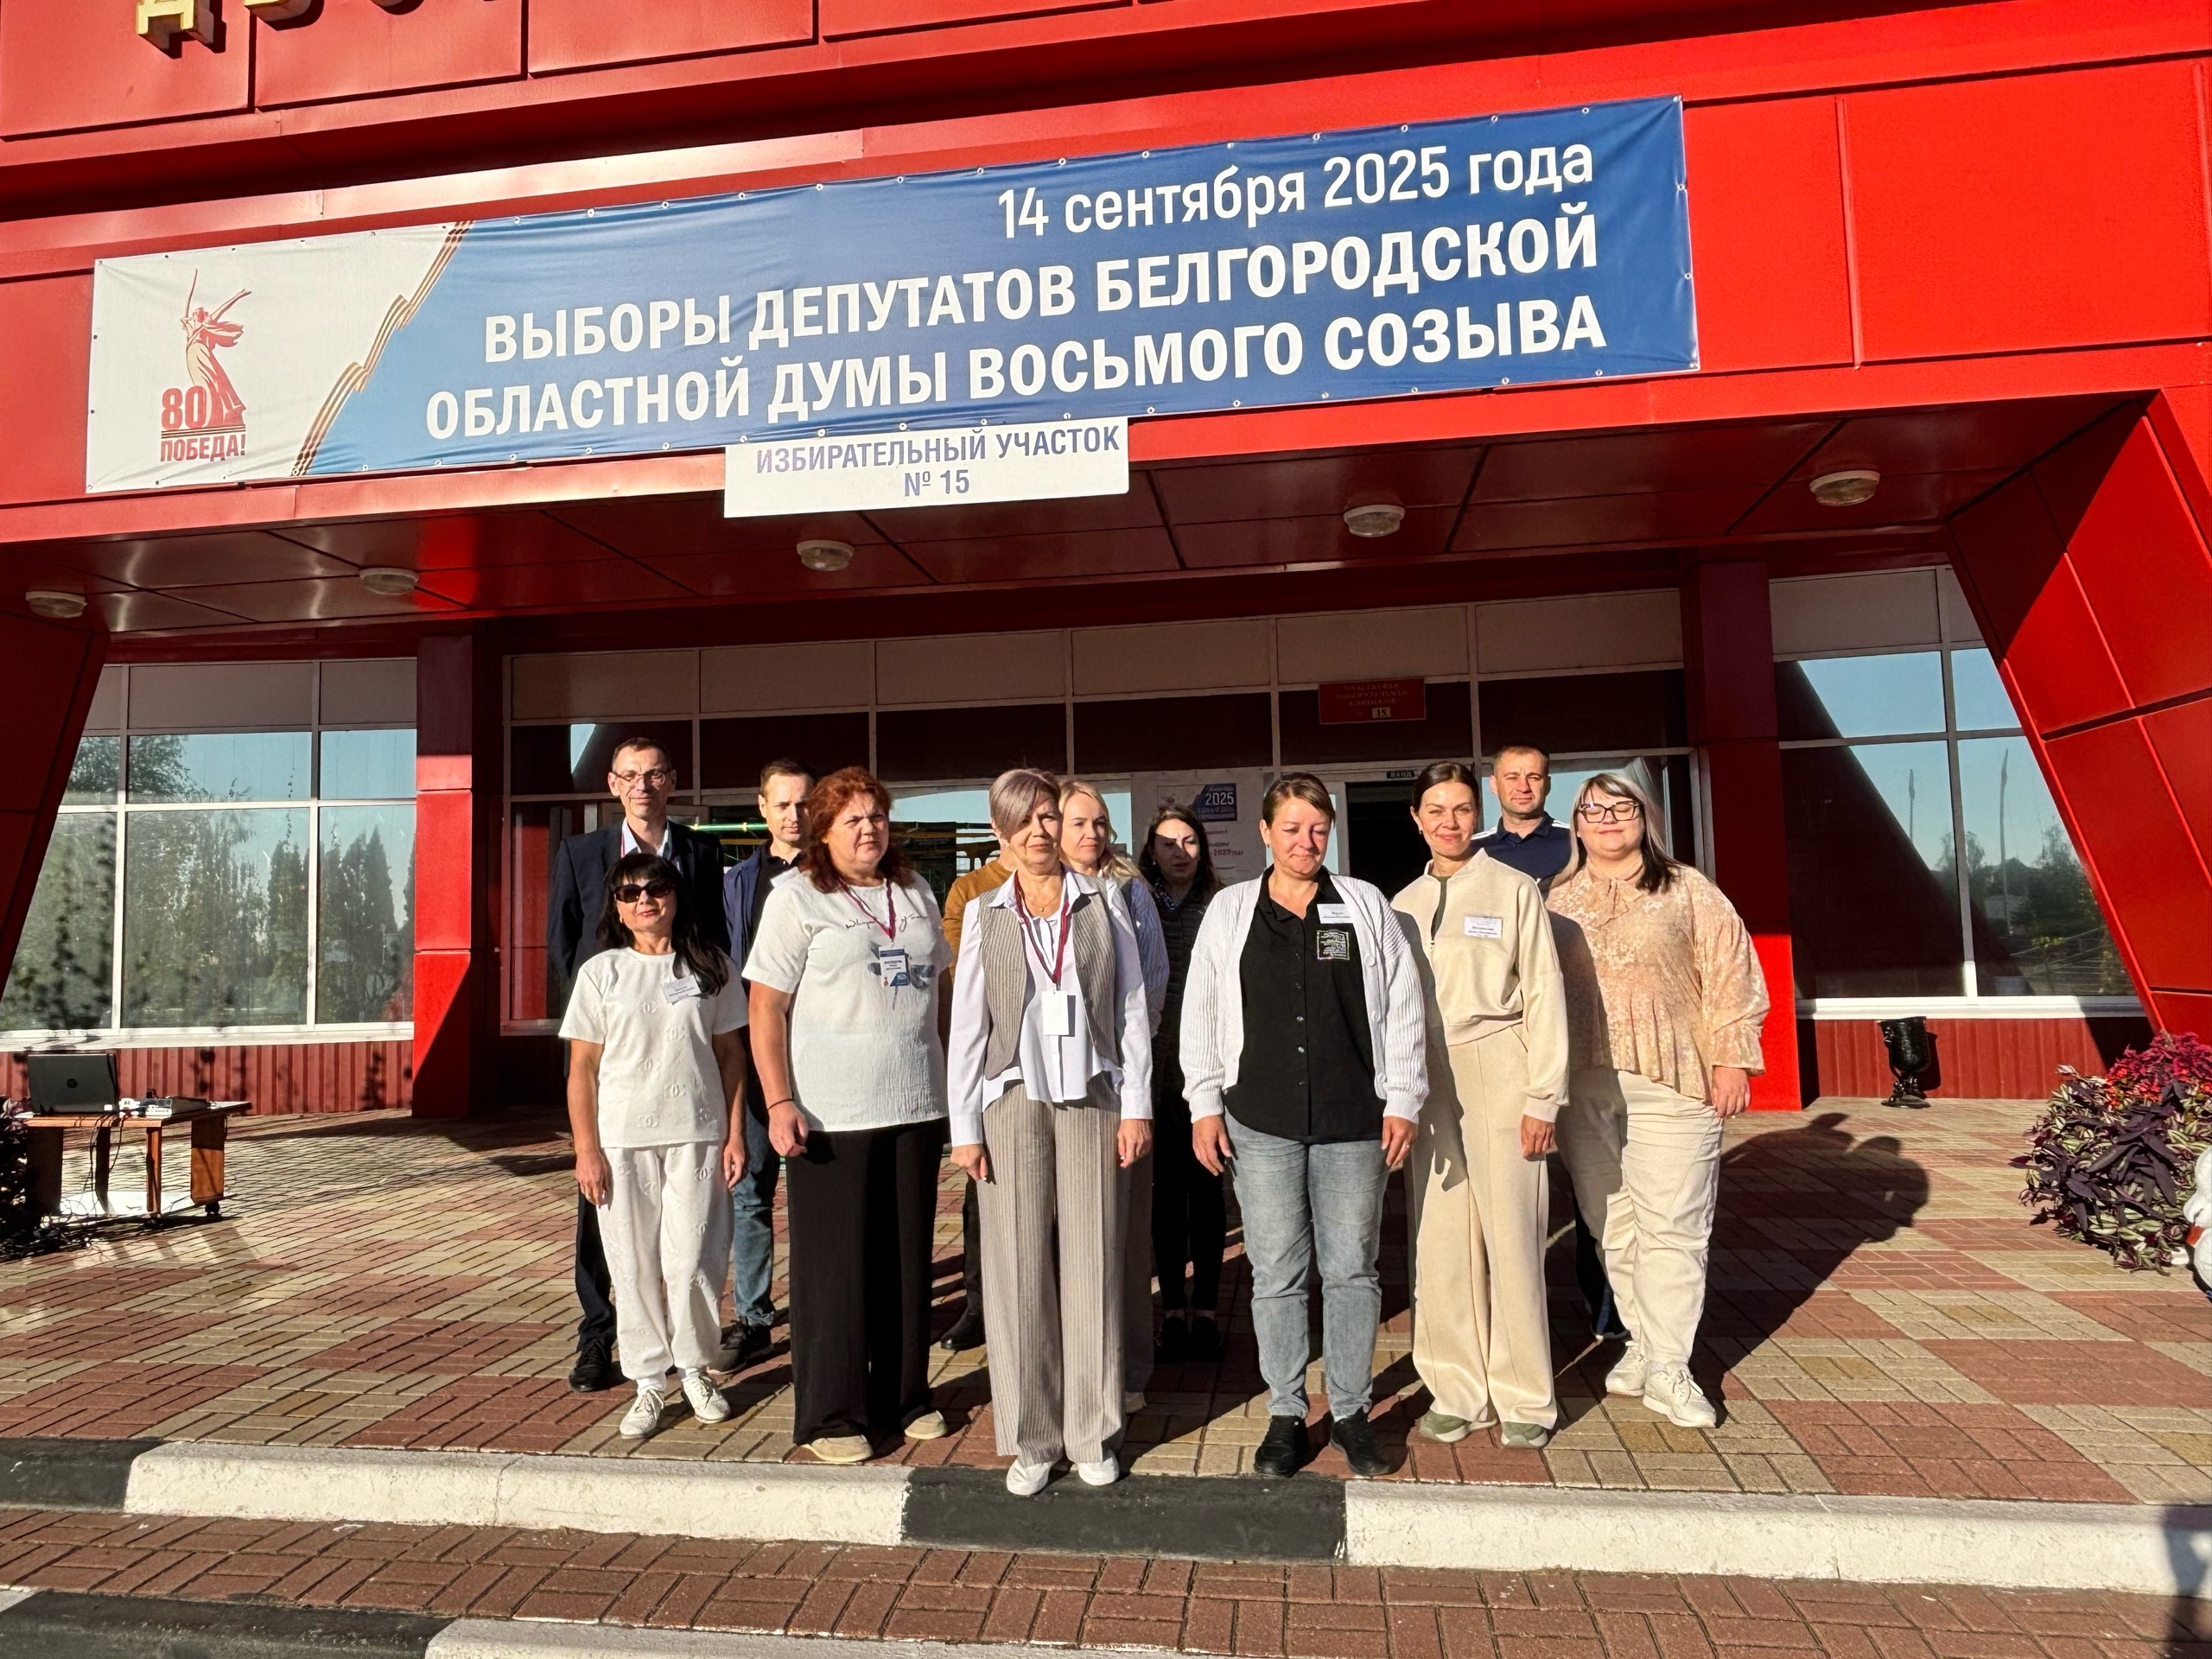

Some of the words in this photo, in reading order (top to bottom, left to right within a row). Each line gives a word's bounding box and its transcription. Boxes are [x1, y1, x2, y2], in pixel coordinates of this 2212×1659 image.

[998, 187, 1049, 238] 14
[1065, 164, 1306, 233] сентября
[1323, 146, 1450, 208] 2025
[1470, 143, 1593, 195] года
[484, 295, 730, 363] ВЫБОРЫ
[748, 264, 1076, 350] ДЕПУТАТОВ
[1096, 201, 1598, 312] БЕЛГОРОДСКОЙ
[425, 356, 750, 440] ОБЛАСТНОЙ
[767, 355, 948, 423] ДУМЫ
[969, 322, 1303, 400] ВОСЬМОГО
[1324, 295, 1607, 370] СОЗЫВА
[162, 385, 207, 430] 80
[160, 434, 246, 462] ПОБЕДА!
[756, 429, 986, 474] ИЗБИРАТЕЛЬНЫЙ
[995, 425, 1121, 458] УЧАСТОК
[939, 469, 969, 494] 15
[1205, 791, 1234, 805] 2025
